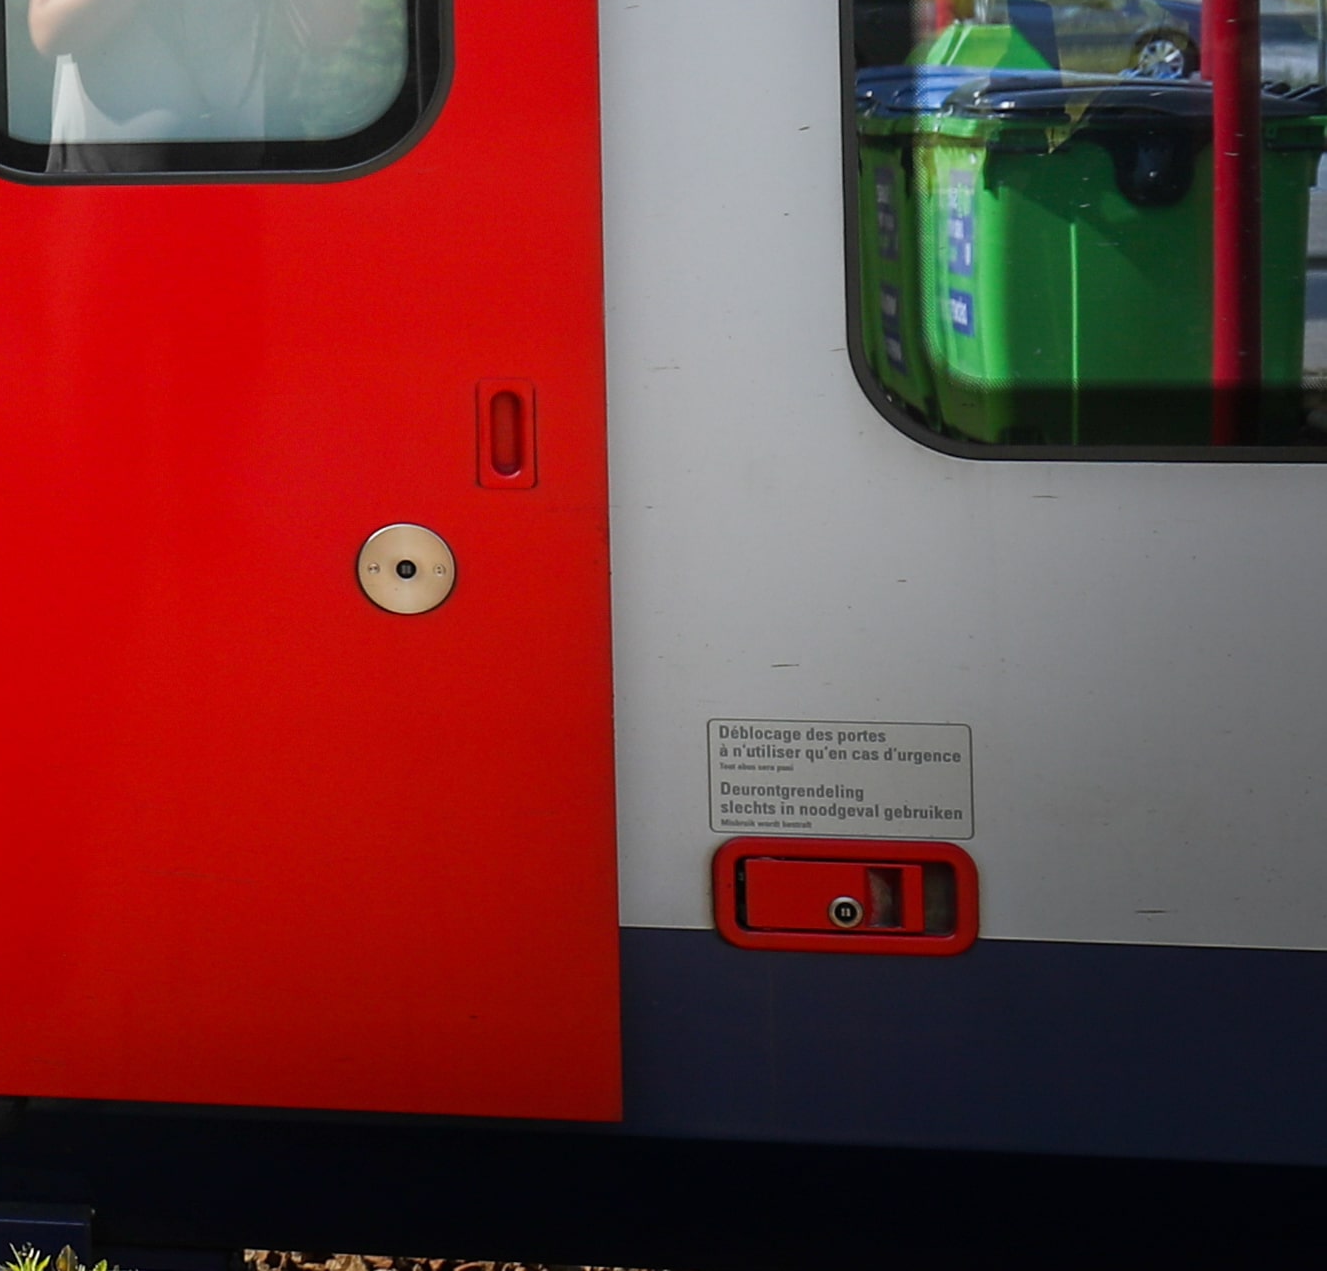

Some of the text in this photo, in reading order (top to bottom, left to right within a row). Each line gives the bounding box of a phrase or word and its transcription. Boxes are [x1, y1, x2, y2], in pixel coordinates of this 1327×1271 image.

[719, 724, 886, 745] Déblocage des portes
[719, 743, 728, 757] à
[852, 749, 879, 761] cas
[720, 781, 865, 802] Deurontgrendeling
[720, 801, 963, 823] slechts in noodgeval gebruiken
